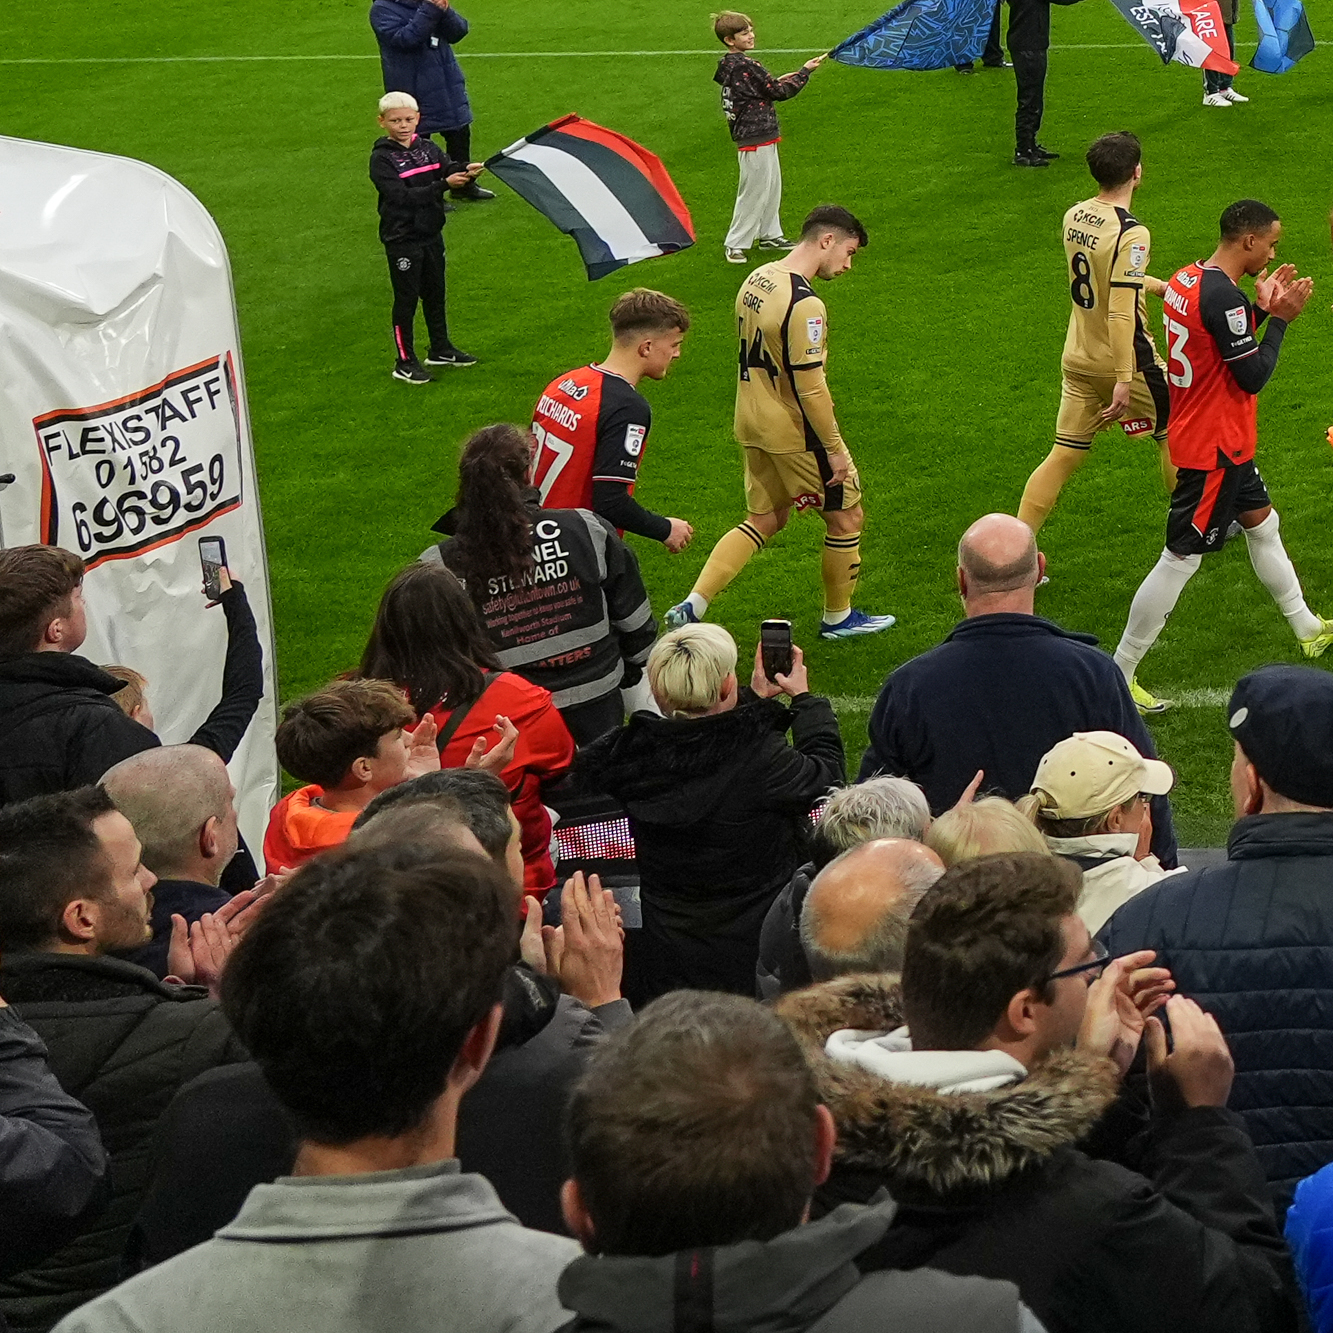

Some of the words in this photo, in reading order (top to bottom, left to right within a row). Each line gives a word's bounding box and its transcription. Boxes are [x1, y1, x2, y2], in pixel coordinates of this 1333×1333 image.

[1066, 228, 1099, 251] SPENCE
[743, 291, 765, 314] GORE
[1070, 251, 1095, 310] 8
[43, 376, 221, 466] FLEXISTAFF
[536, 394, 582, 432] RICHARDS
[72, 453, 224, 553] 696959
